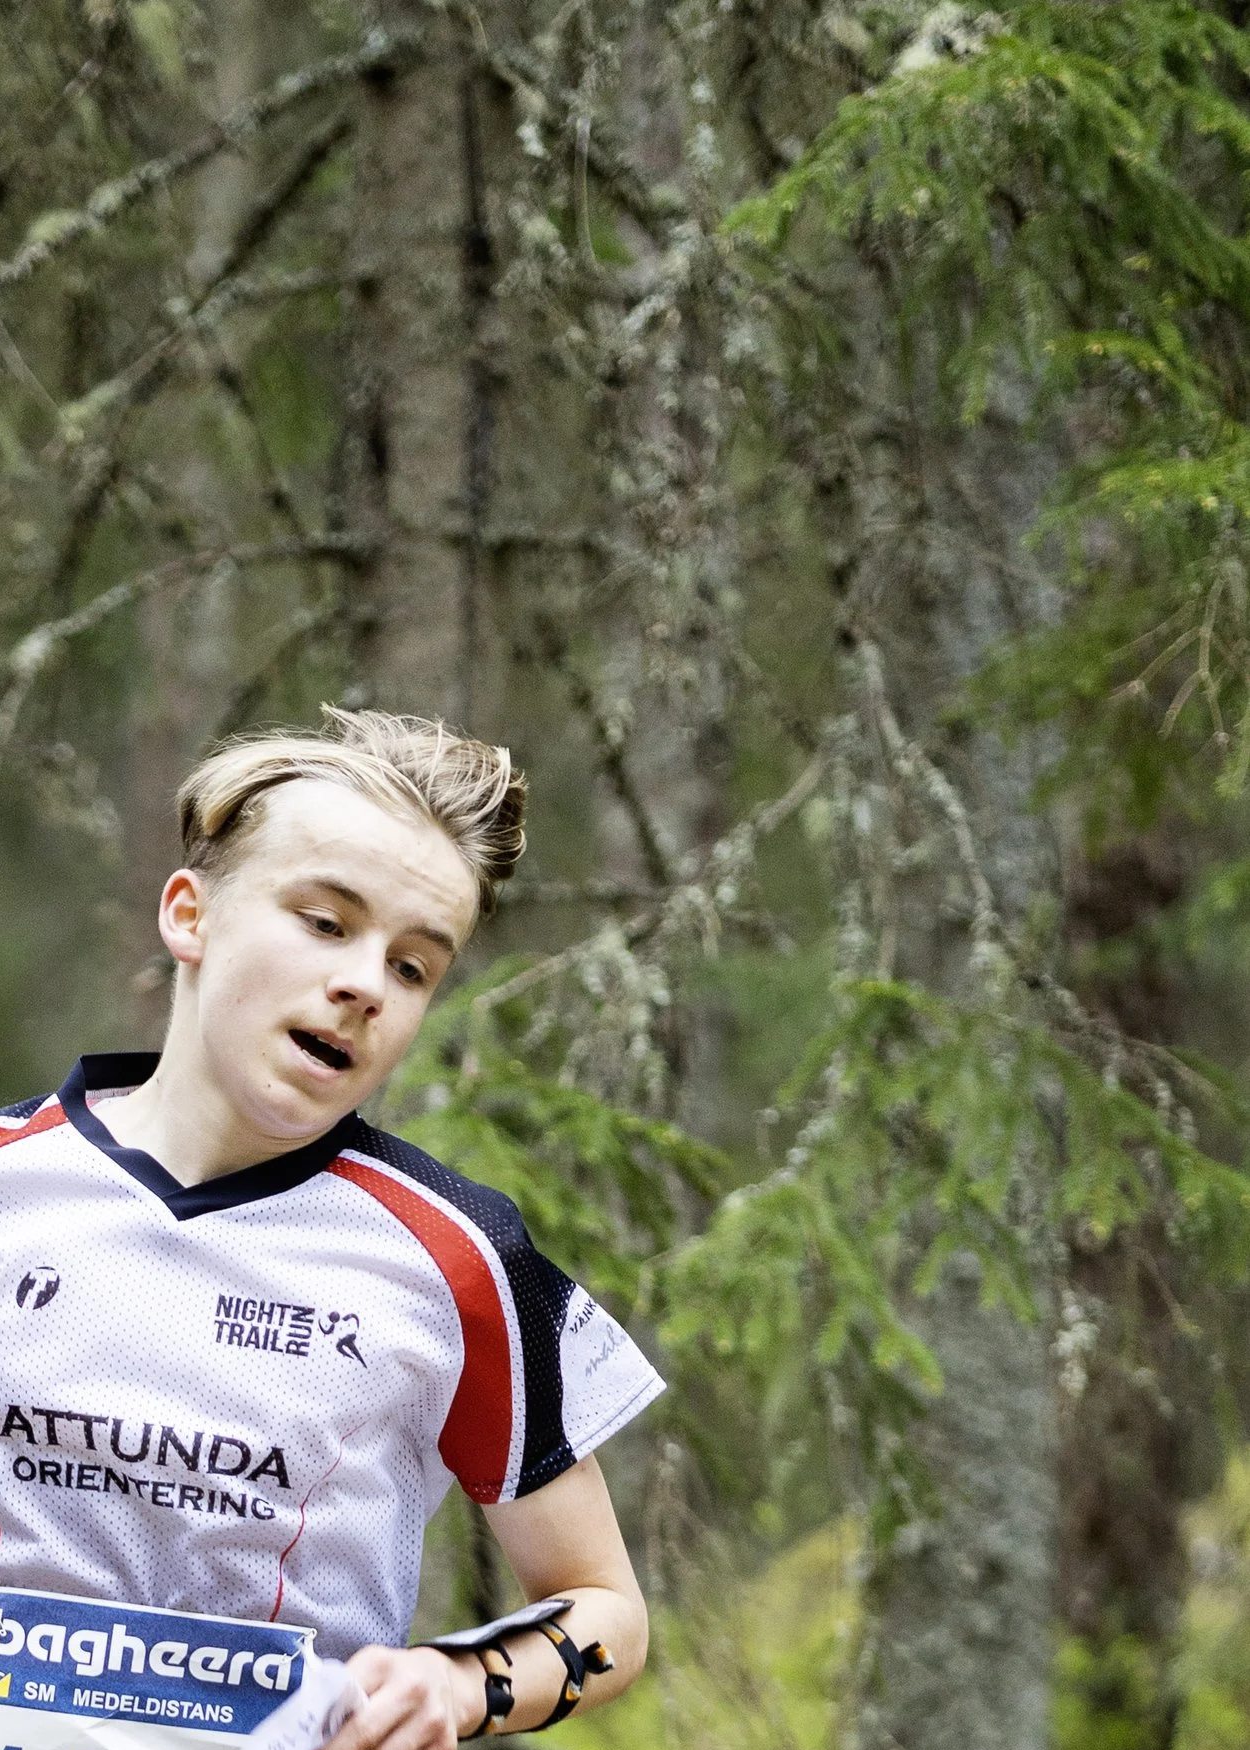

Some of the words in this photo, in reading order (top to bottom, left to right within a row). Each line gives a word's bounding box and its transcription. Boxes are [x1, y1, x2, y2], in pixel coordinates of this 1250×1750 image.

[215, 1293, 291, 1327] NIGHT
[285, 1303, 316, 1357] RUN
[214, 1319, 284, 1353] TRAIL
[0, 1403, 292, 1489] ATTUNDA
[11, 1455, 276, 1520] ORIENTERING
[23, 1680, 56, 1703] SM
[72, 1689, 234, 1724] MEDELDISTANS
